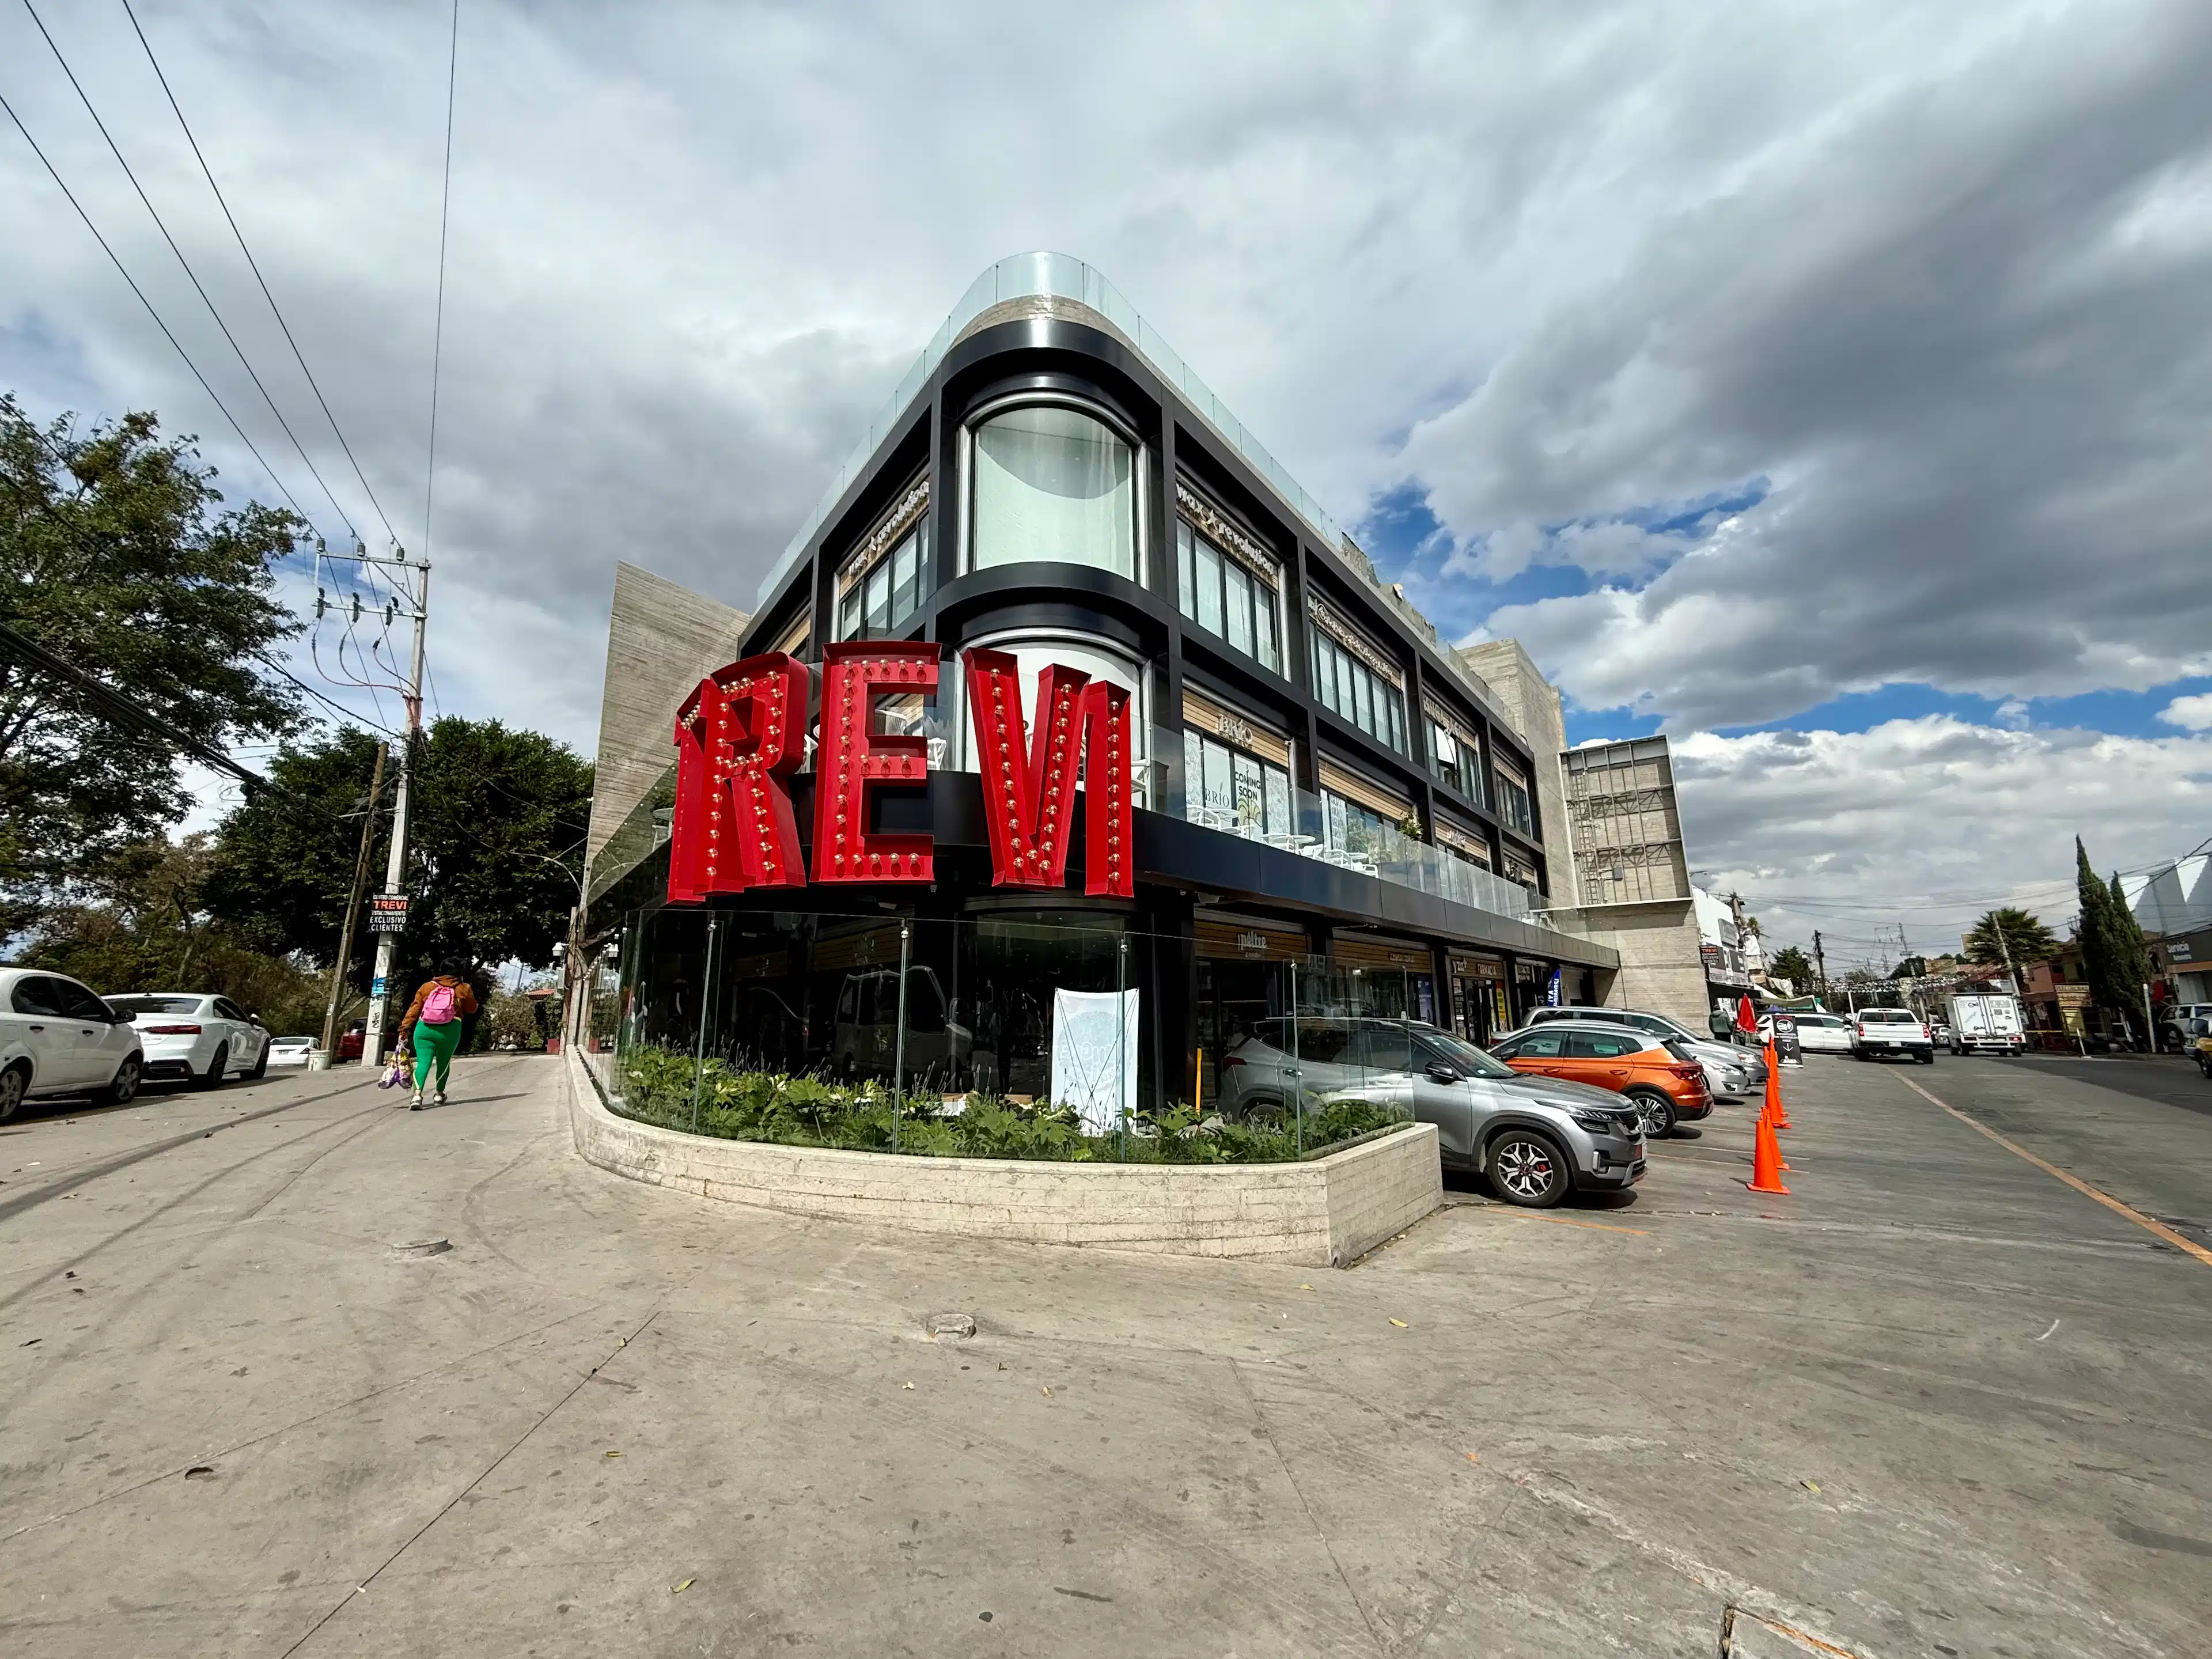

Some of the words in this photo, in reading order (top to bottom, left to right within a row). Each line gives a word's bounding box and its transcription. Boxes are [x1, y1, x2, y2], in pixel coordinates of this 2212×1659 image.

[1218, 522, 1274, 575] revolution
[1235, 771, 1261, 790] COMING
[1238, 785, 1257, 801] SOON
[373, 900, 407, 910] TREVI
